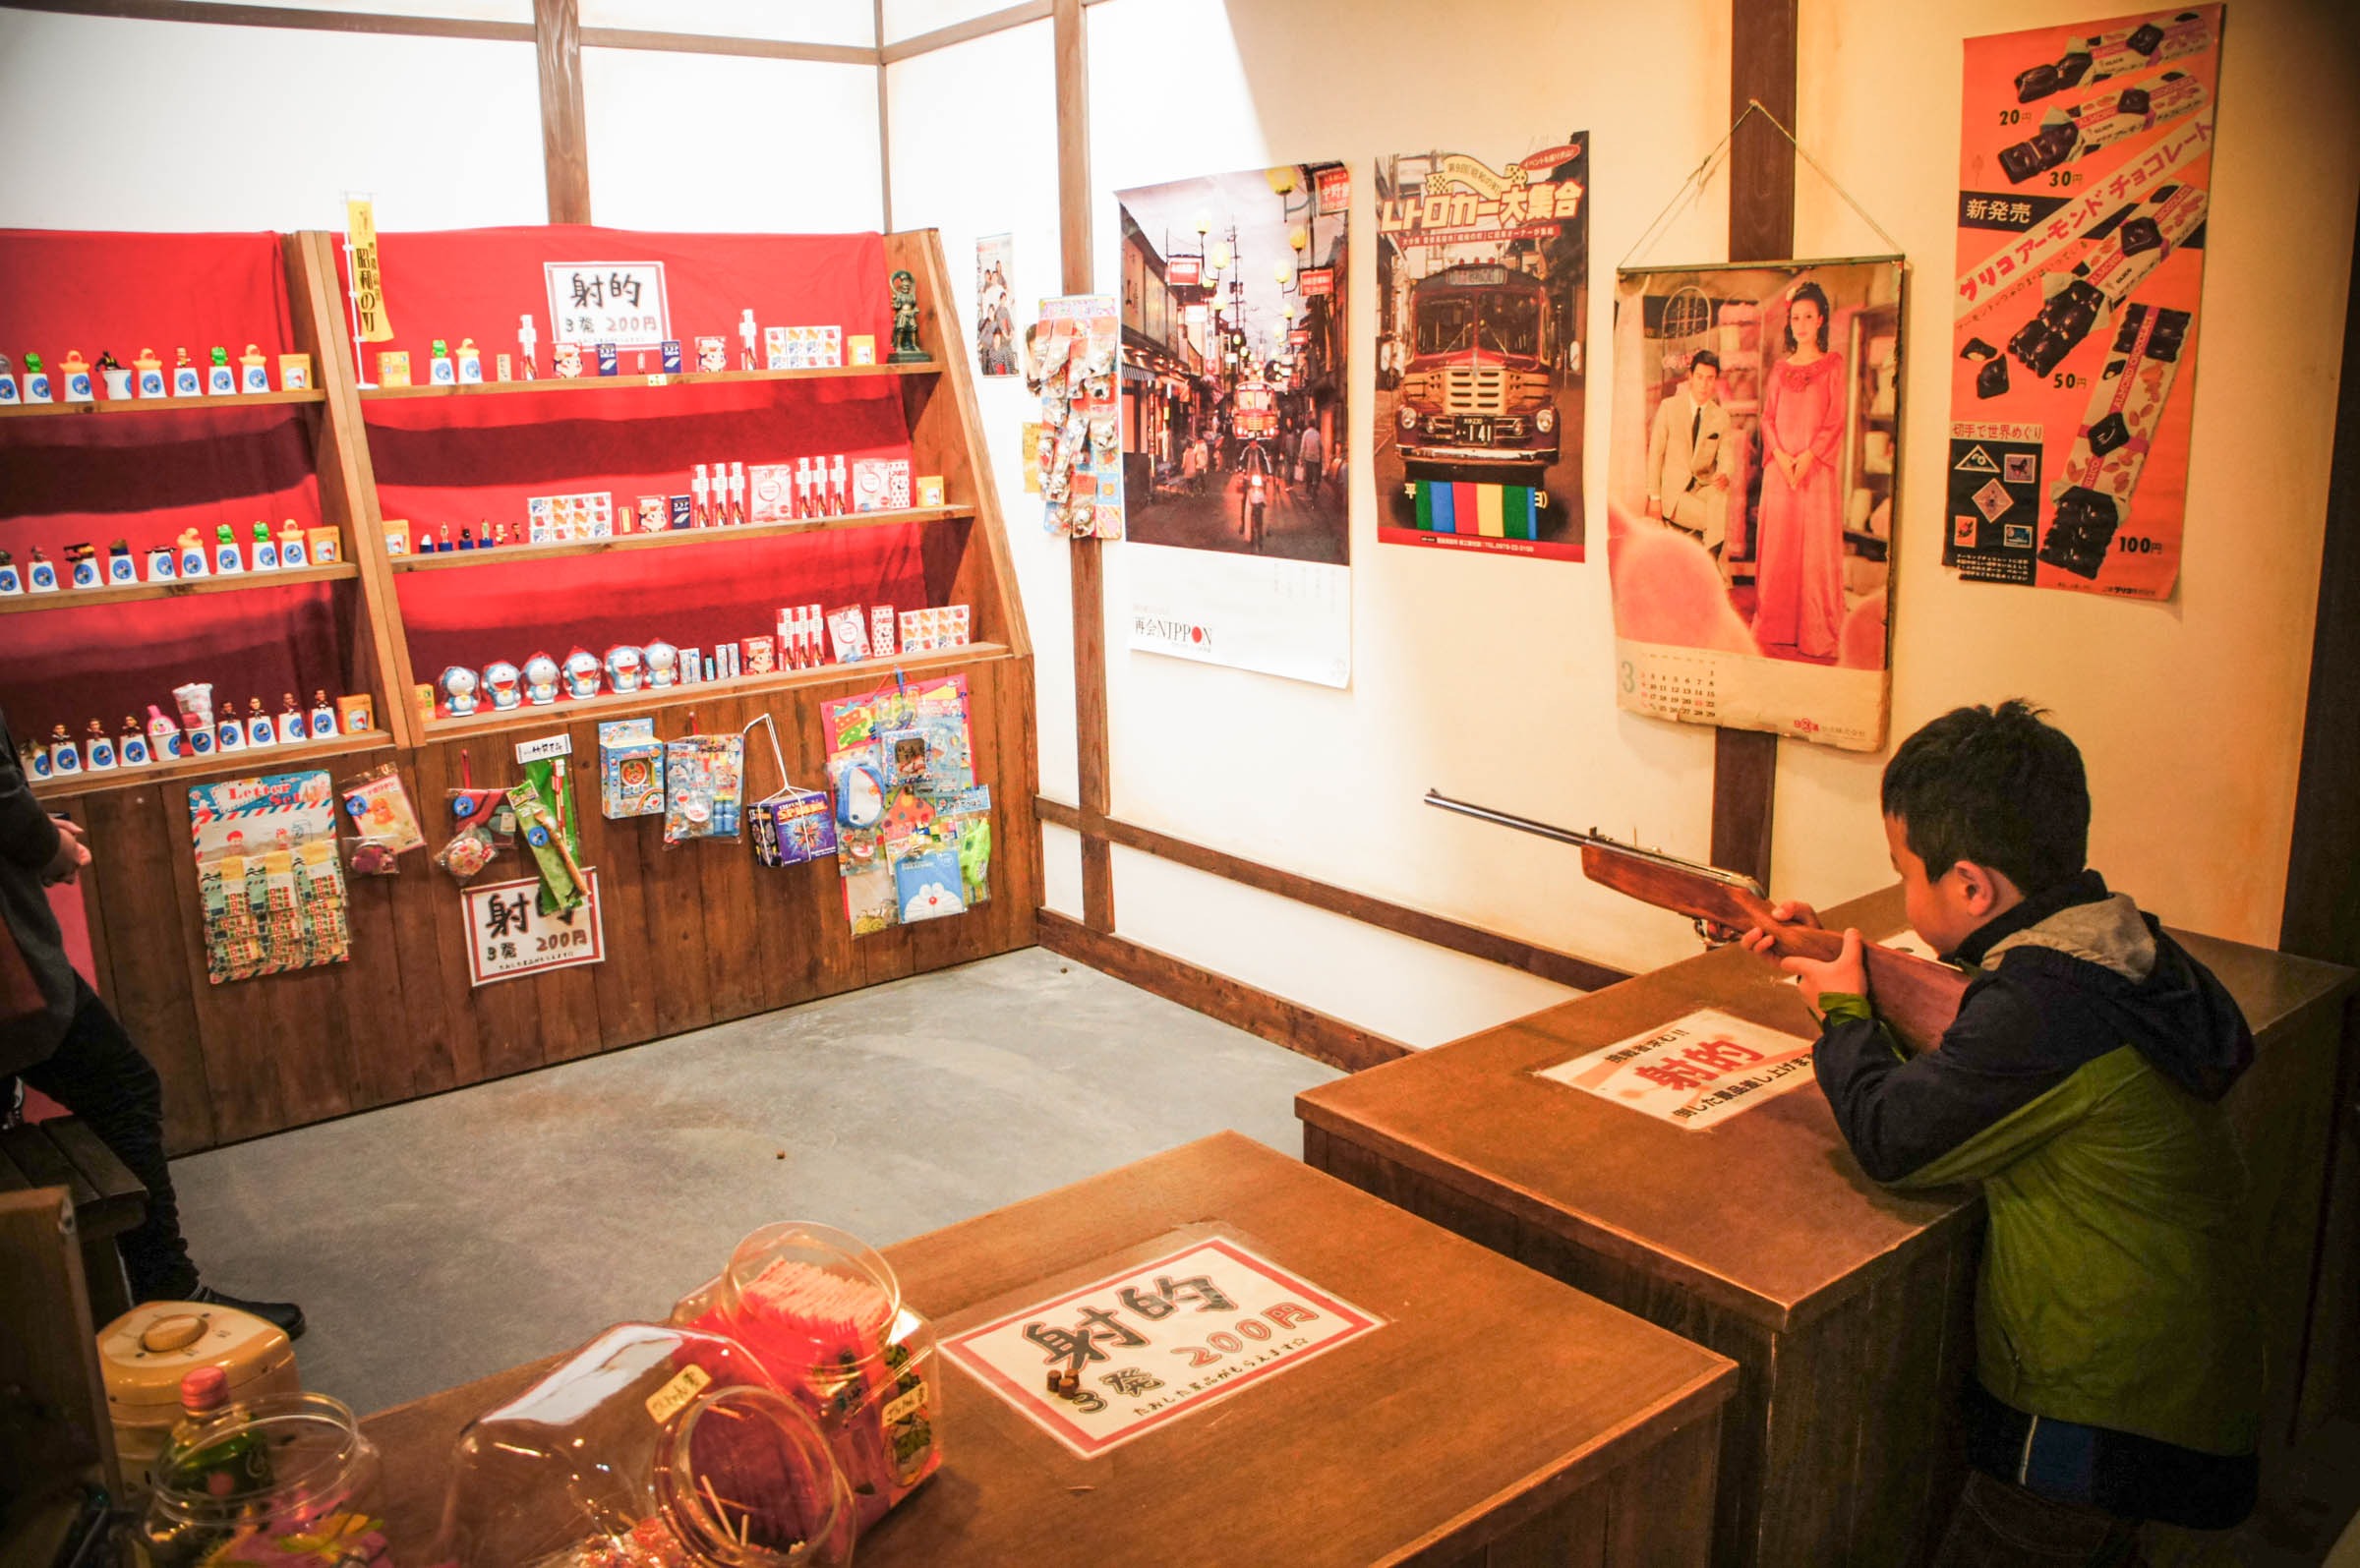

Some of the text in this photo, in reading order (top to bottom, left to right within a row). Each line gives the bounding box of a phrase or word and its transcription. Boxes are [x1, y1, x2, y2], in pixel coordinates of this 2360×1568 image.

[1999, 110, 2032, 126] 20円
[2048, 171, 2083, 187] 30円
[1381, 180, 1584, 233] レトロカー大集合
[1967, 199, 2032, 224] 新発売
[570, 272, 641, 309] 射的
[607, 316, 657, 332] 200円
[2053, 373, 2087, 389] 50円
[1953, 423, 2042, 440] 切手で世界めぐり
[2119, 536, 2162, 555] 100円
[1622, 661, 1635, 693] 3
[228, 784, 291, 800] Letter
[269, 791, 301, 805] Set
[536, 929, 588, 953] 200円
[1633, 1039, 1765, 1091] 射的
[1022, 1274, 1239, 1371] 射的
[1070, 1302, 1321, 1414] 3発 200円
